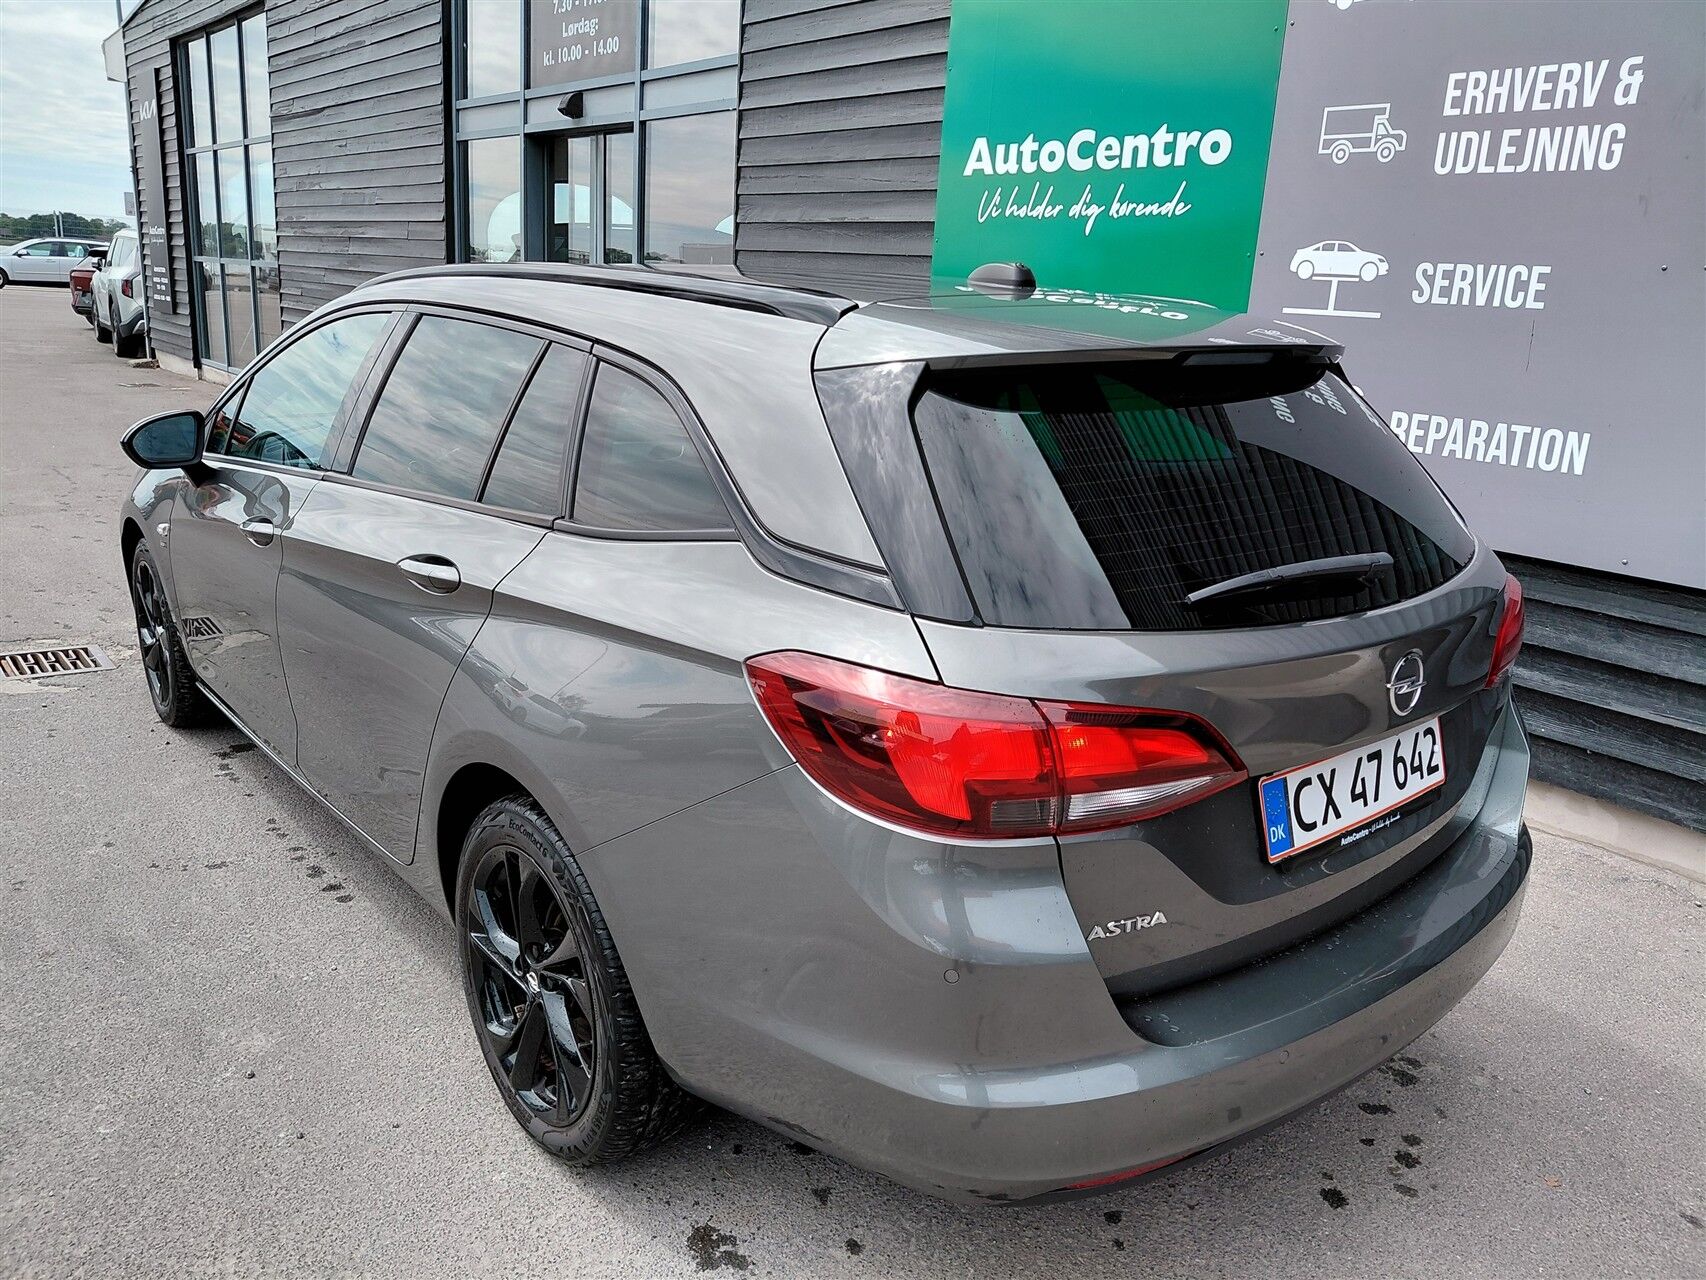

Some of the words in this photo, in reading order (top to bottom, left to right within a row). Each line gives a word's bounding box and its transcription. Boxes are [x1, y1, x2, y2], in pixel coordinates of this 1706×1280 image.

[543, 50, 555, 66] kl.
[558, 44, 582, 63] 10.00
[593, 36, 620, 56] 14.00
[562, 17, 599, 37] Lørdag:
[1442, 59, 1610, 116] ERHVERV
[1613, 55, 1645, 106] &
[962, 123, 1232, 176] AutoCentro
[1433, 122, 1627, 175] UDLEJNING
[977, 186, 1002, 224] Vi
[1004, 181, 1064, 219] holder
[1068, 184, 1105, 236] dig
[1411, 262, 1552, 310] SERVICE
[1389, 410, 1591, 476] REPARATION
[1293, 767, 1343, 833] CX
[1350, 748, 1383, 808] 47
[1392, 726, 1440, 791] 642
[1269, 822, 1287, 844] DK
[1086, 911, 1168, 941] ASTRA
